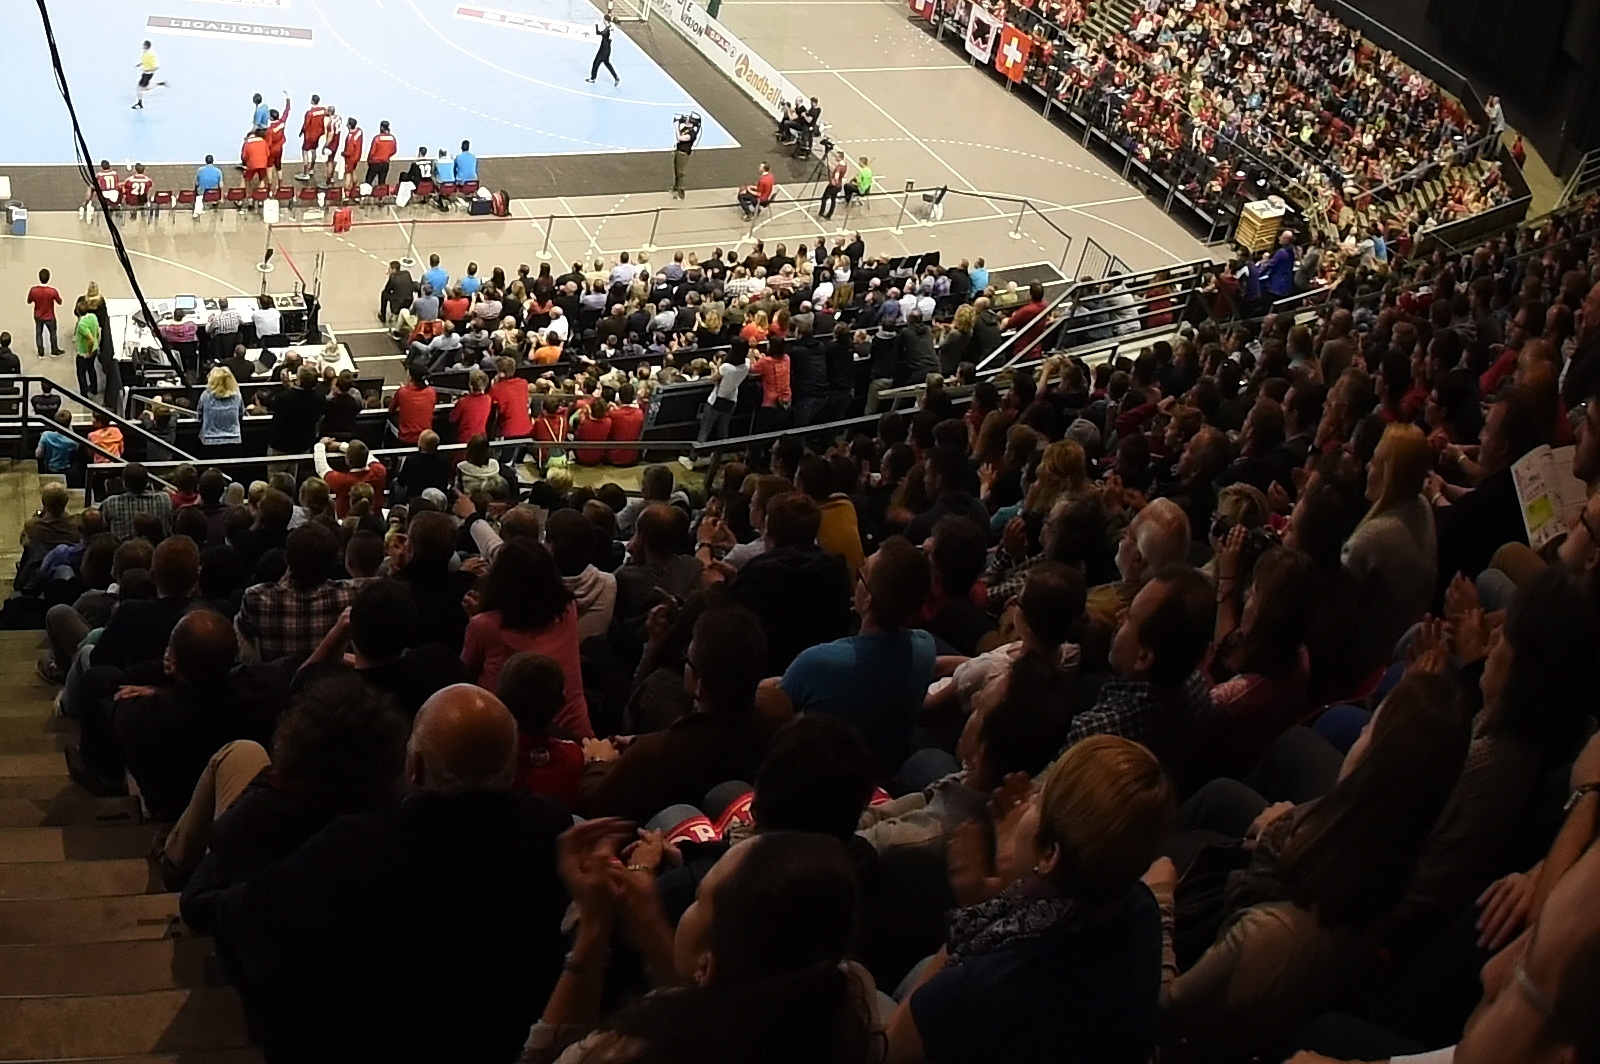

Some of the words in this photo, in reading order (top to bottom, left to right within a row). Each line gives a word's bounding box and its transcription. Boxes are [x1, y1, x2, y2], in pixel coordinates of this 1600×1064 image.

[169, 18, 291, 37] LEGALJOB.ch
[103, 175, 115, 190] 11
[131, 182, 146, 196] 21
